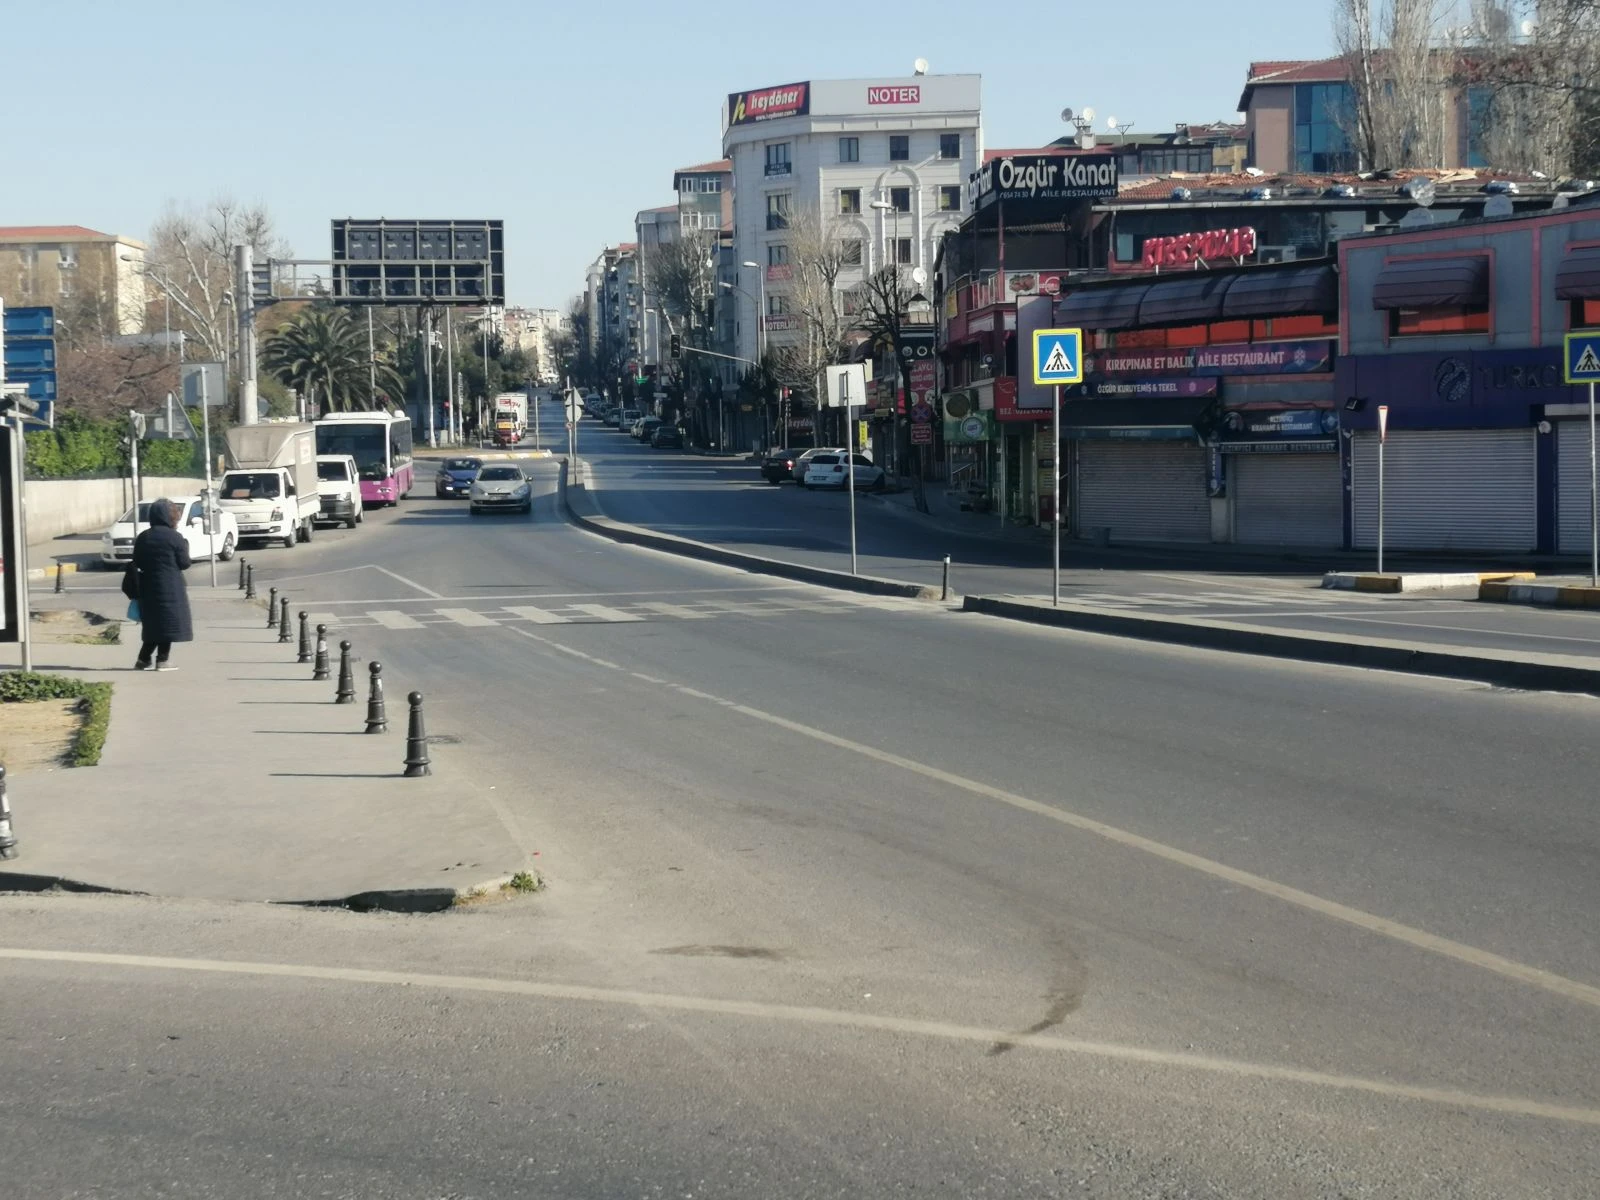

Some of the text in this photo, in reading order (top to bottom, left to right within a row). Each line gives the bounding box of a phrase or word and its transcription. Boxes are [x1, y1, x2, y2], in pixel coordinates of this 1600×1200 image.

[751, 89, 799, 111] heydöner
[869, 88, 918, 102] NOTER
[999, 156, 1117, 198] Özgür Kanat
[1061, 188, 1116, 198] RESTAURANT
[1106, 351, 1285, 371] KIRKPINAR ET BALIK AİLE RESTAURANT
[1158, 382, 1178, 392] TEKEL
